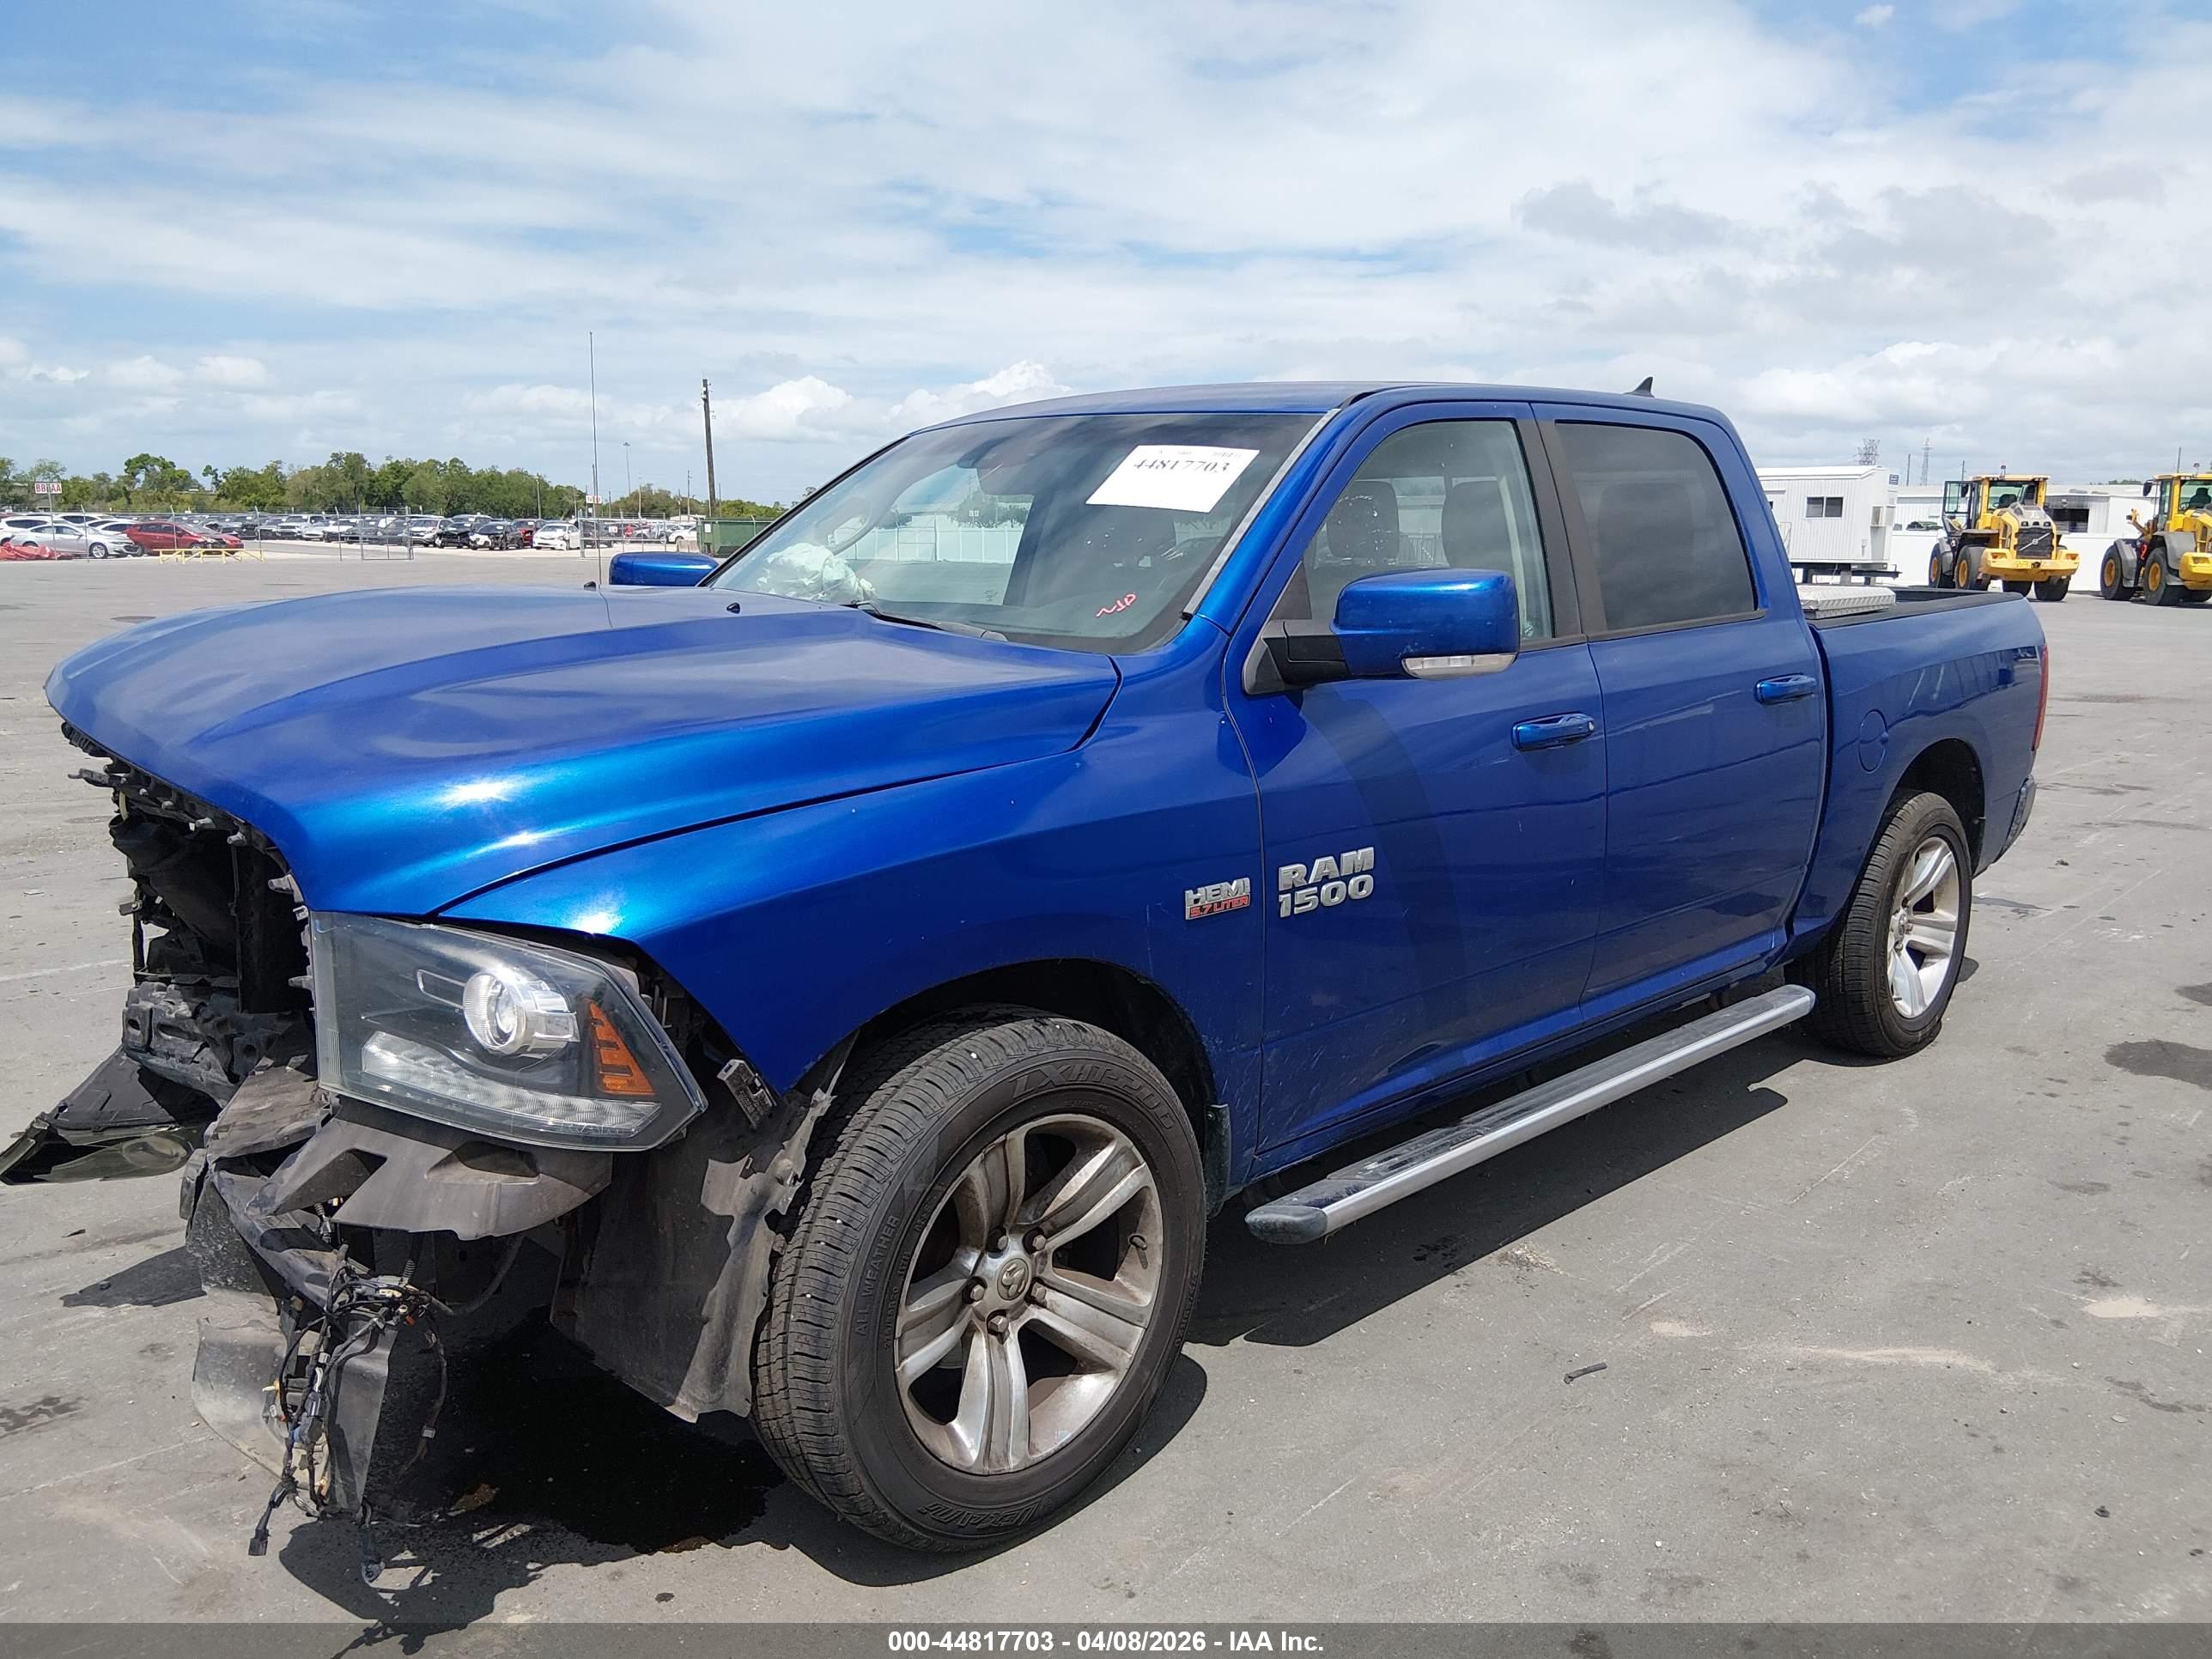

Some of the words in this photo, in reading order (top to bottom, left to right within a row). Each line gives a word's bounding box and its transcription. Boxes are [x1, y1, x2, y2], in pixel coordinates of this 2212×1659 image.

[1133, 458, 1231, 473] 44817703
[1278, 847, 1374, 891] RAM
[1185, 877, 1250, 906] HEMI
[1188, 903, 1212, 918] 5.7
[1212, 895, 1249, 912] LITER
[1278, 874, 1374, 918] 1500
[860, 1214, 900, 1297] WEATHER
[855, 1305, 869, 1337] ALL
